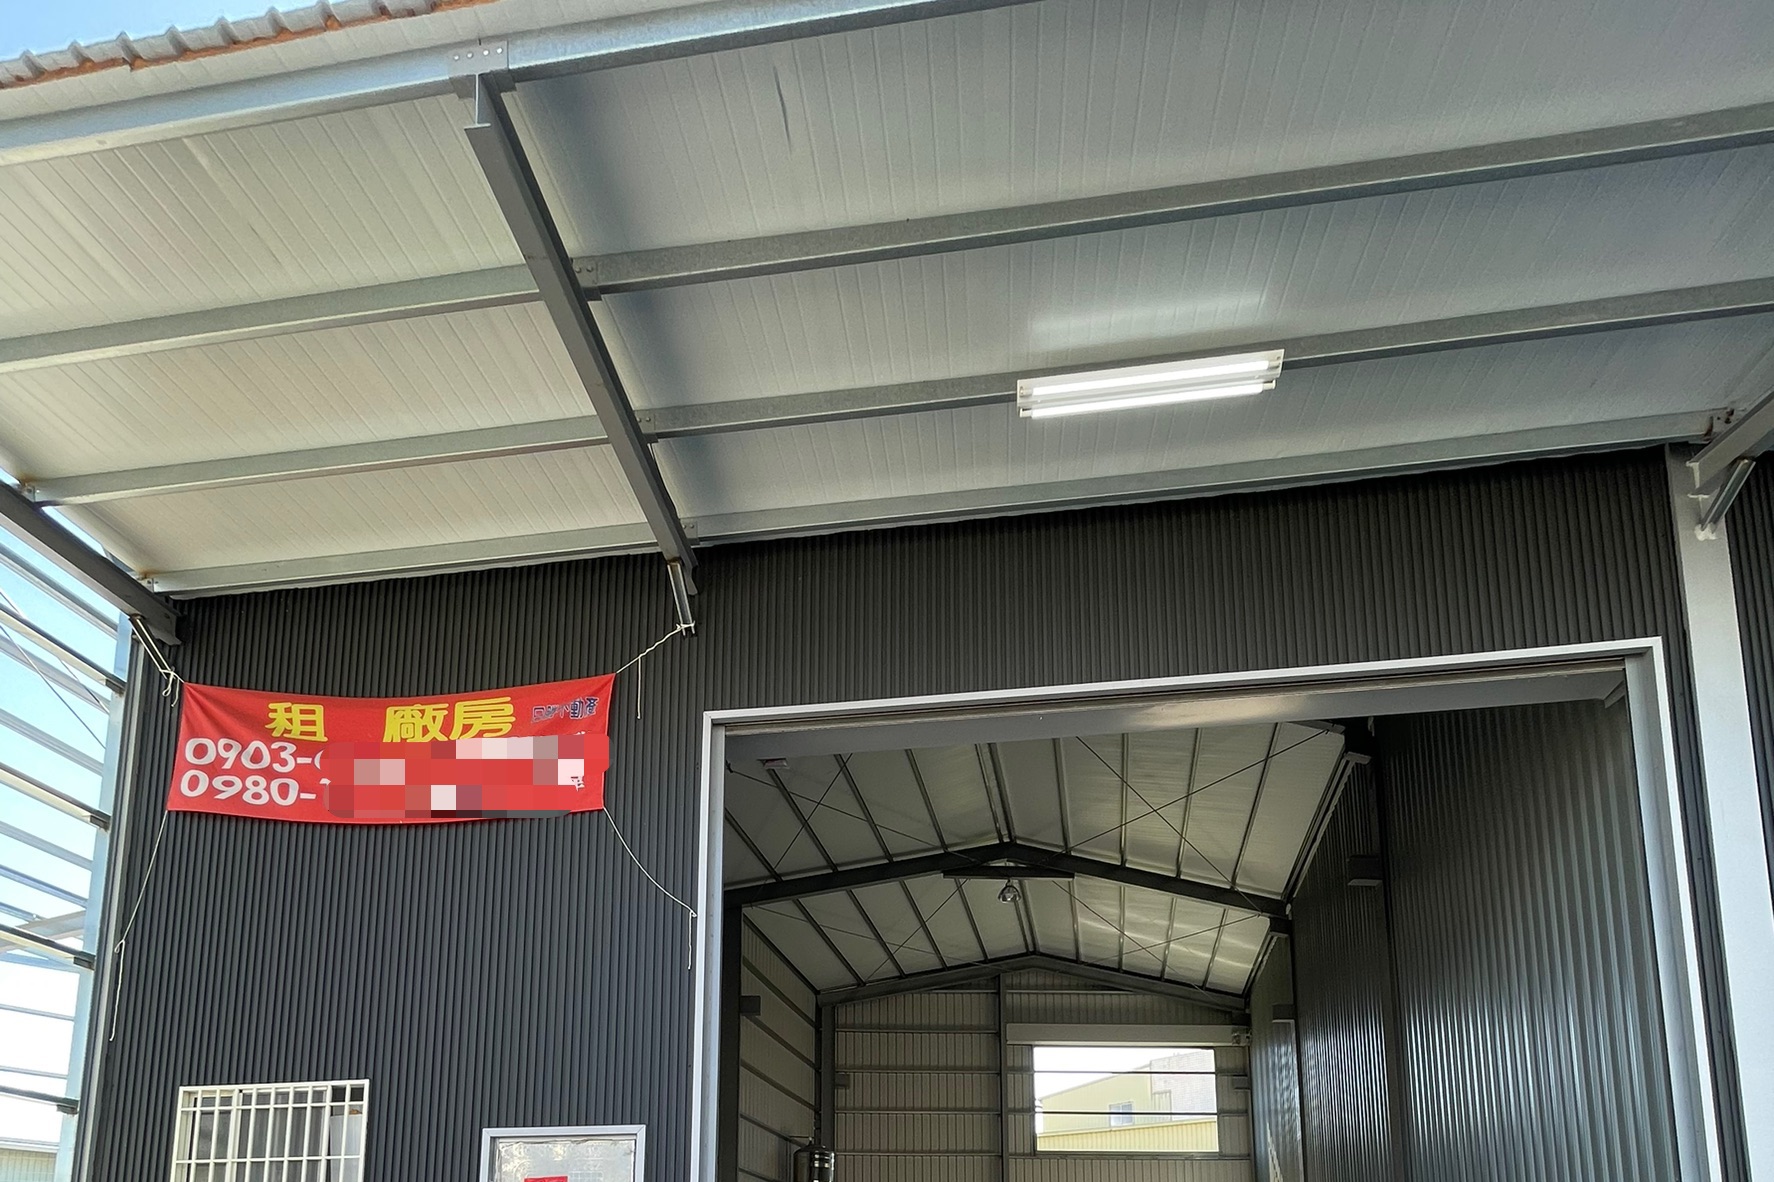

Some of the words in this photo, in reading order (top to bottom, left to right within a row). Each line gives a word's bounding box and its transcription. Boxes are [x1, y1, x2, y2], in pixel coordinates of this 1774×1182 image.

[265, 702, 328, 742] 租
[383, 696, 516, 743] 廠房
[184, 737, 324, 773] 0903-
[180, 769, 331, 806] 0980-
